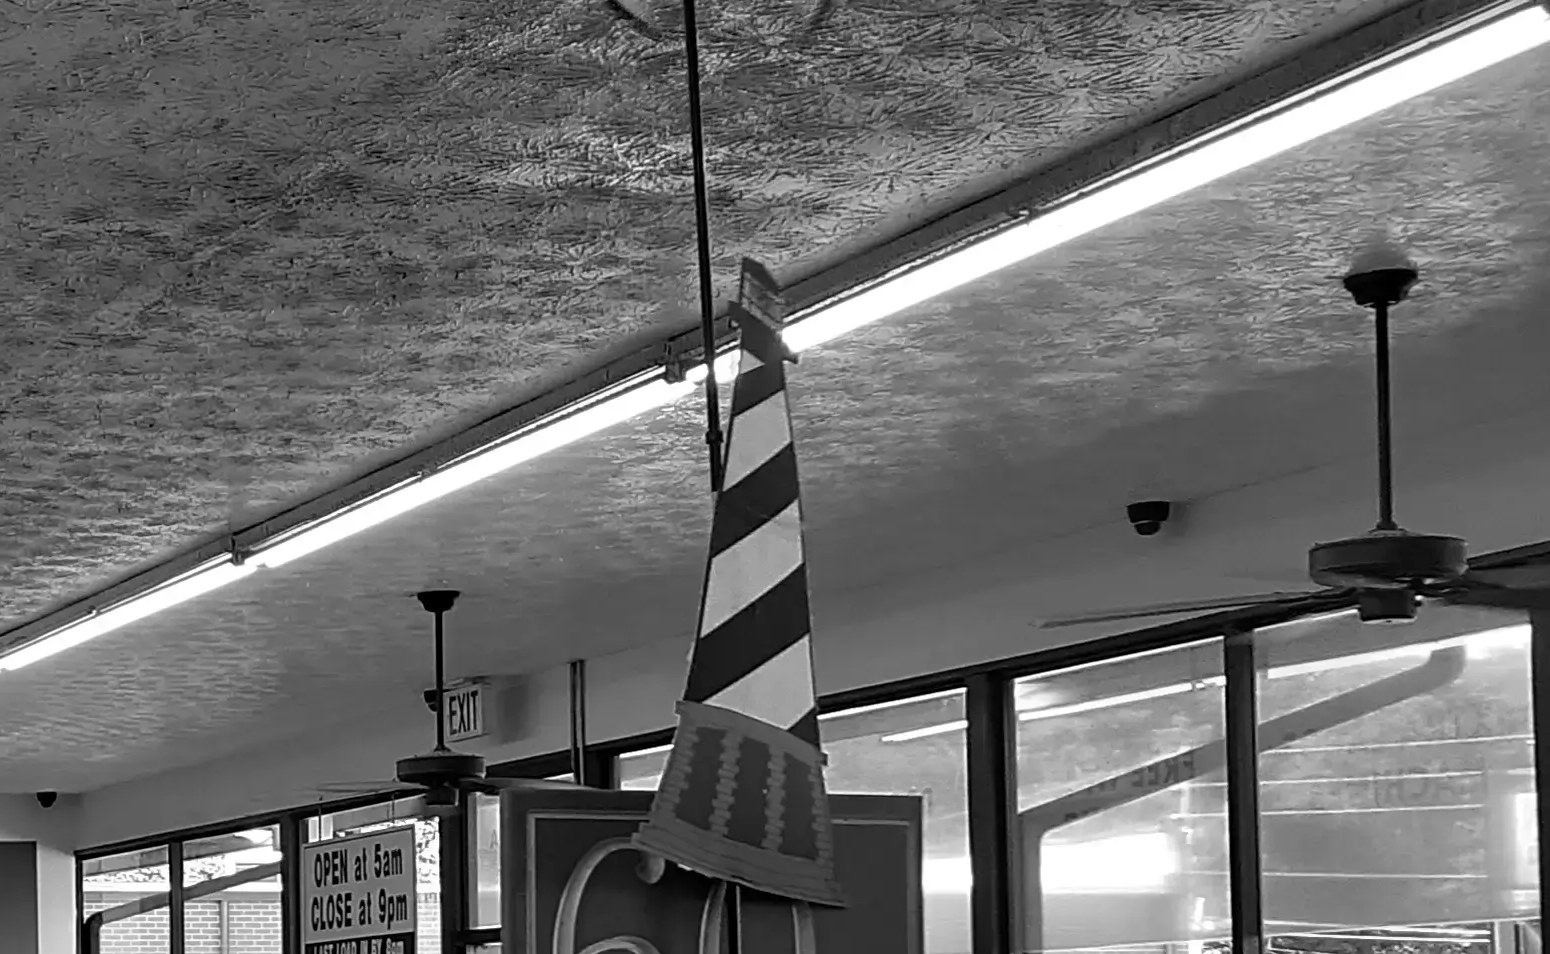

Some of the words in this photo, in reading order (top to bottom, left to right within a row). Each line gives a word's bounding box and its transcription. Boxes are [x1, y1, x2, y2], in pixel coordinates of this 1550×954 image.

[449, 690, 479, 735] EXIT
[314, 849, 348, 888] OPEN
[354, 847, 368, 881] at
[374, 843, 403, 878] 5am
[311, 893, 352, 932] CLOSE
[358, 892, 372, 926] at
[378, 888, 408, 930] 9pm
